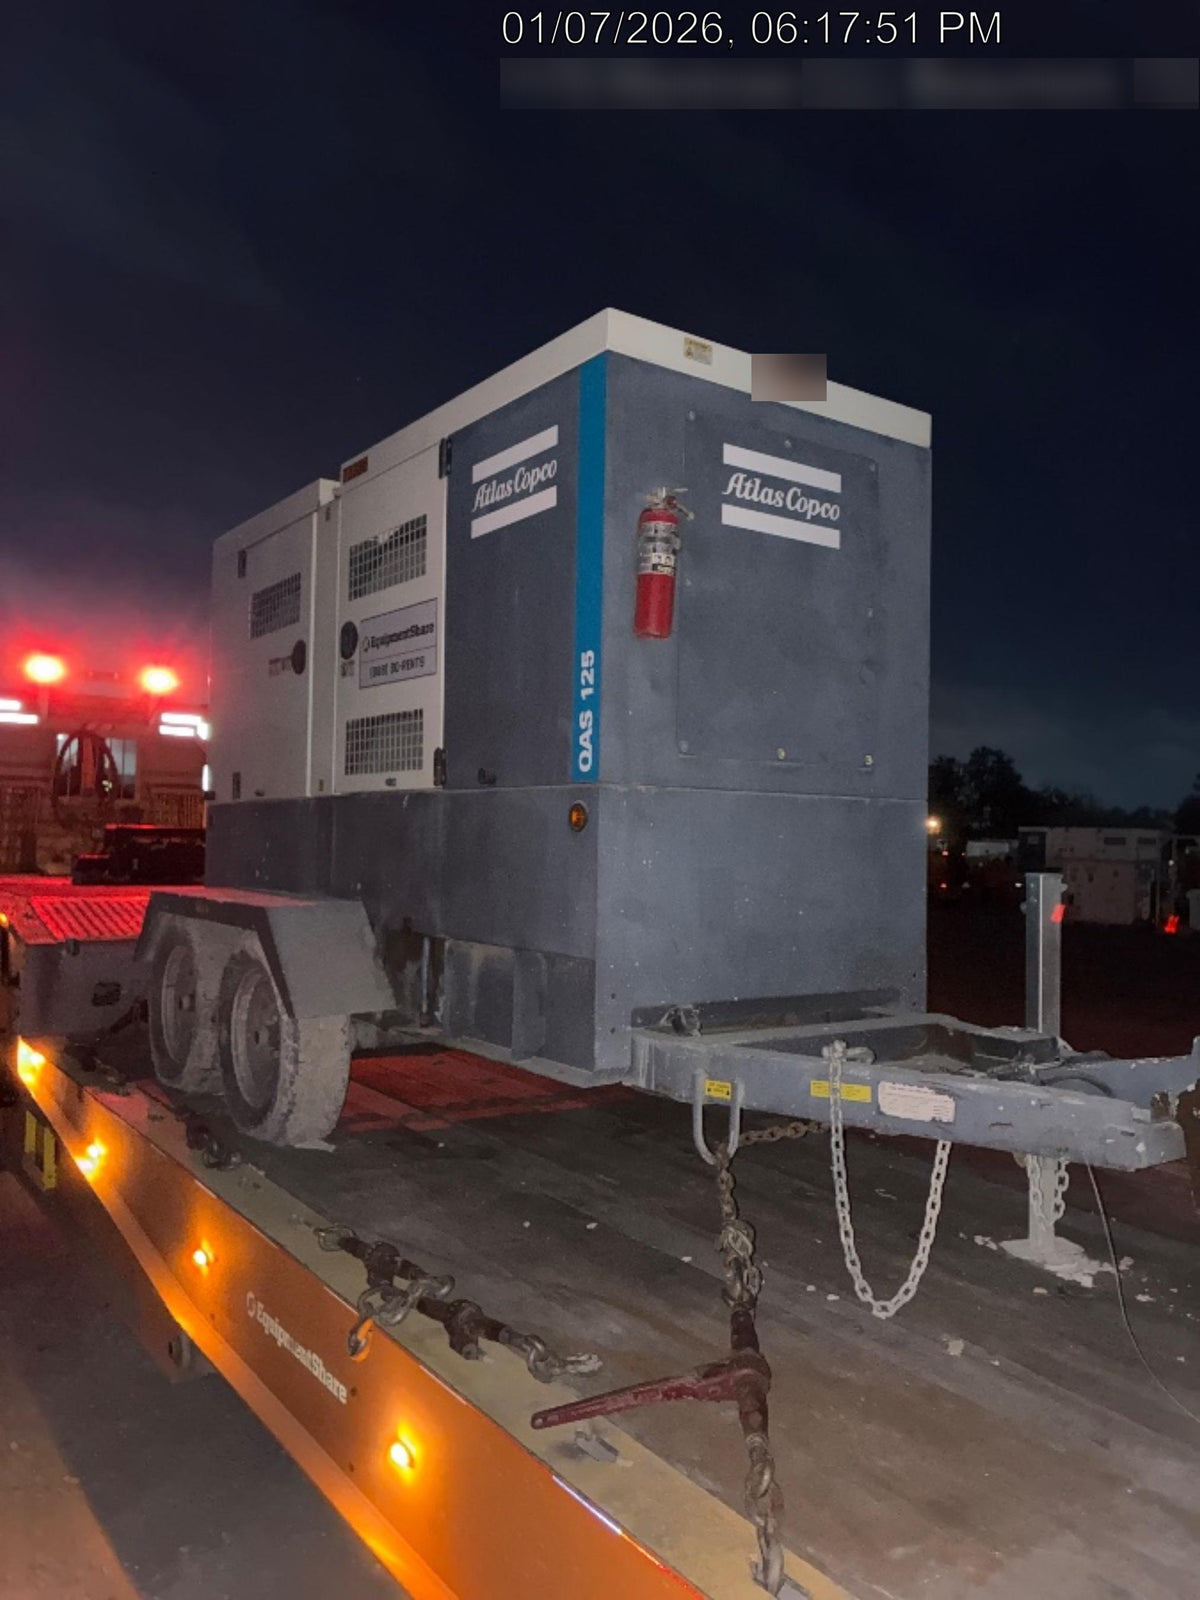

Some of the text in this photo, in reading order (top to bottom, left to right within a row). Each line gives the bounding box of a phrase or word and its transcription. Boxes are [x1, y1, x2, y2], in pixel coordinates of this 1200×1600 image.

[472, 459, 557, 512] Atlas Copco
[723, 472, 841, 521] Atlas Copco
[370, 622, 435, 649] EquipmentShare
[578, 649, 595, 773] QAS 125
[256, 1302, 348, 1405] EquipmentShare
